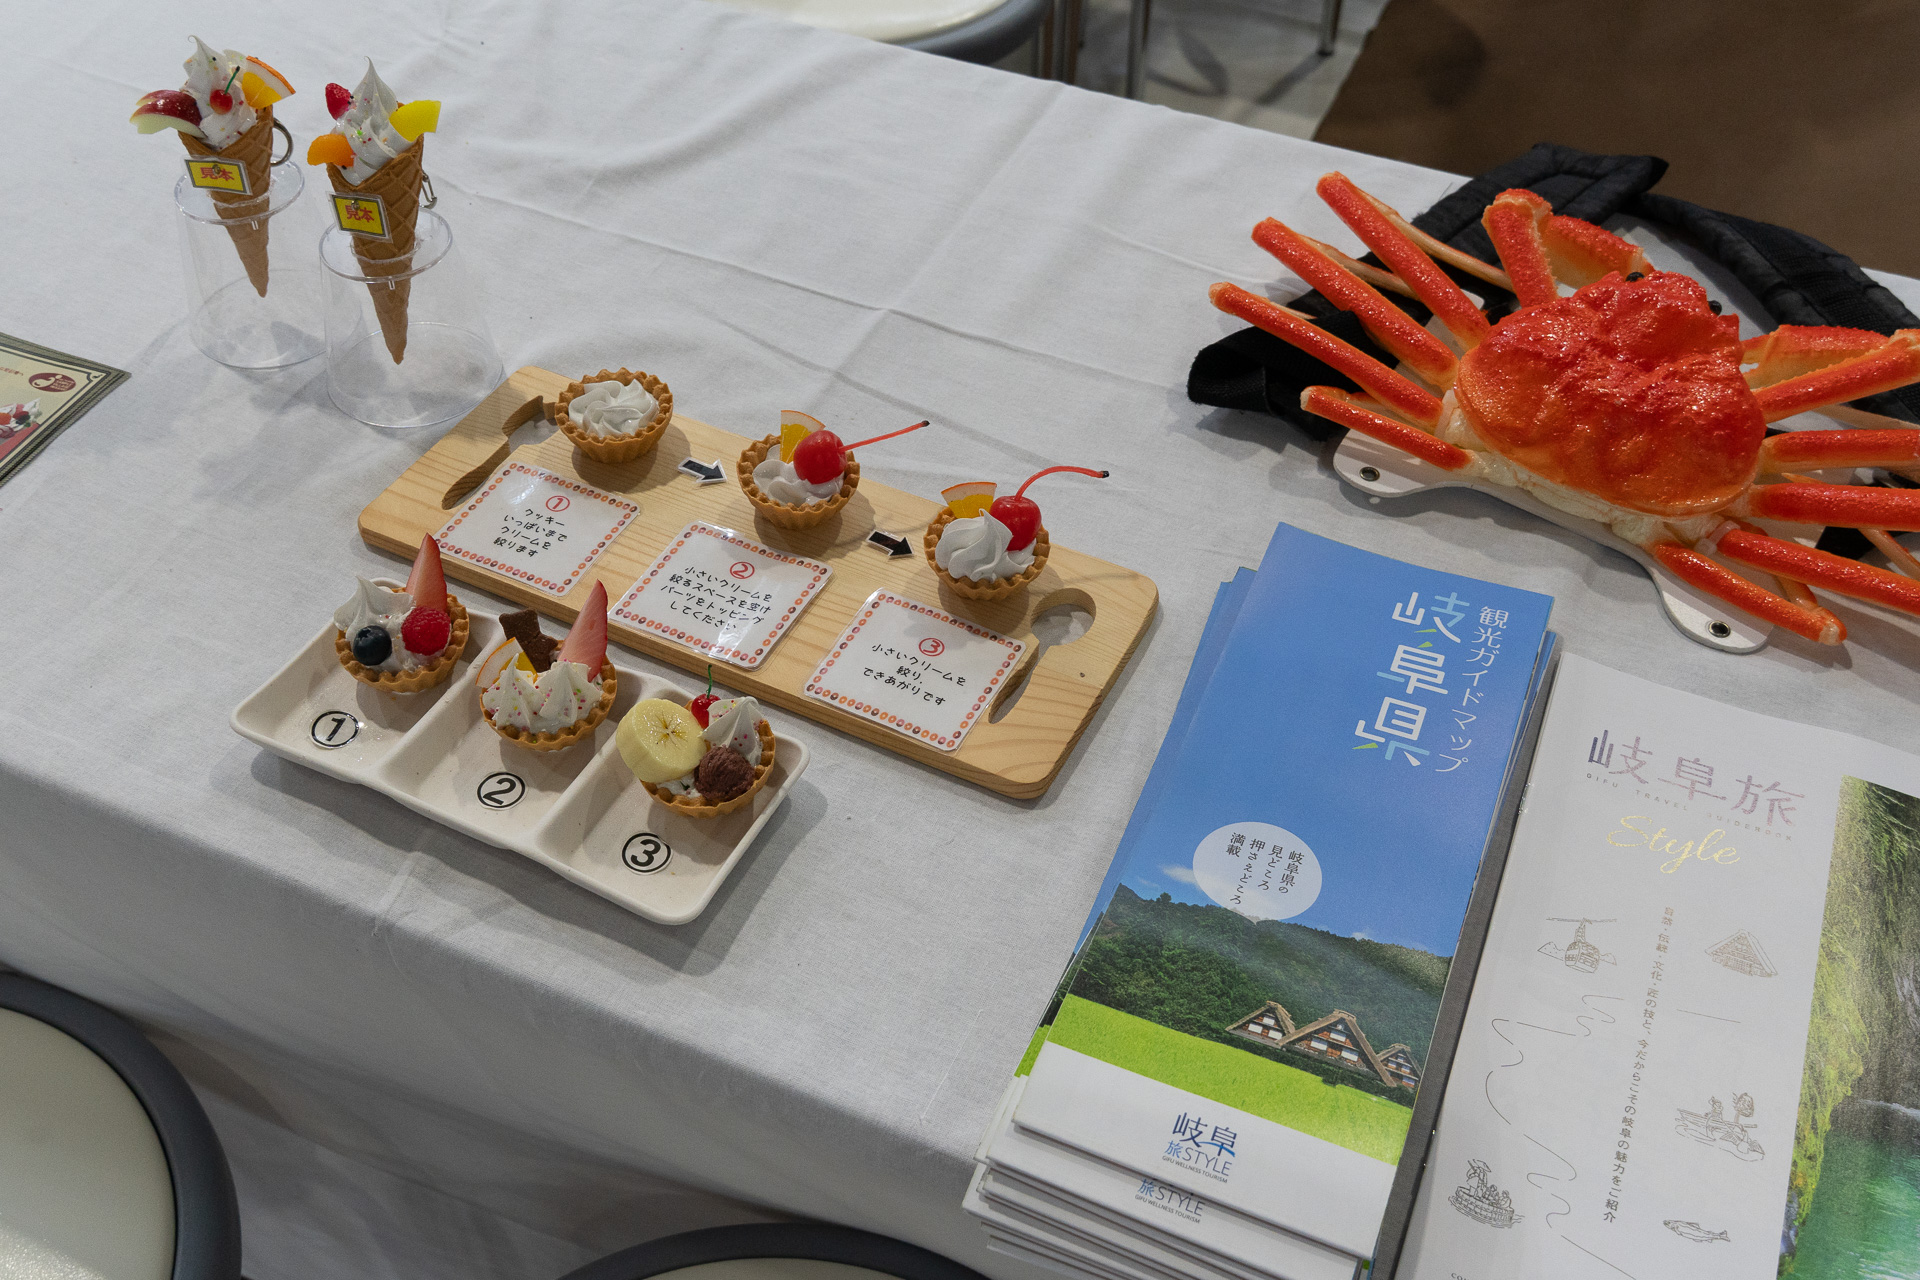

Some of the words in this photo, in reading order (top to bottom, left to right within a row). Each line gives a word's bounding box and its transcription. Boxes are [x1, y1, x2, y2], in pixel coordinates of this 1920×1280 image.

[200, 164, 235, 182] 見本
[345, 205, 375, 223] 見本
[525, 508, 566, 526] クッキー
[493, 537, 539, 557] 絞ります
[500, 526, 552, 550] クリームを
[669, 573, 771, 614] 絞るスペースを空け
[684, 566, 772, 602] 小さいクリームを
[660, 585, 765, 624] パーツをトッピング
[670, 601, 737, 630] してください
[871, 643, 967, 687] 小さいクリームを
[1352, 591, 1470, 767] 岐阜県
[862, 667, 946, 706] できあがりです
[1435, 605, 1509, 772] 観光ガイドマップ
[1588, 729, 1805, 826] 岐阜旅
[1226, 832, 1246, 858] 満載
[1606, 815, 1741, 874] Style
[1230, 838, 1266, 905] 押さえどころ
[1257, 844, 1284, 891] 見どころ
[1278, 850, 1305, 894] 岐阜県の
[1172, 1112, 1237, 1157] 岐阜
[1162, 1155, 1175, 1164] GIFU
[1175, 1159, 1202, 1174] WELLNESS
[1202, 1170, 1228, 1184] TOURISM
[1164, 1140, 1232, 1176] 旅STYLE
[1134, 1194, 1147, 1203] GIFU
[1147, 1199, 1174, 1214] WELLNESS
[1174, 1209, 1201, 1224] TOURISM
